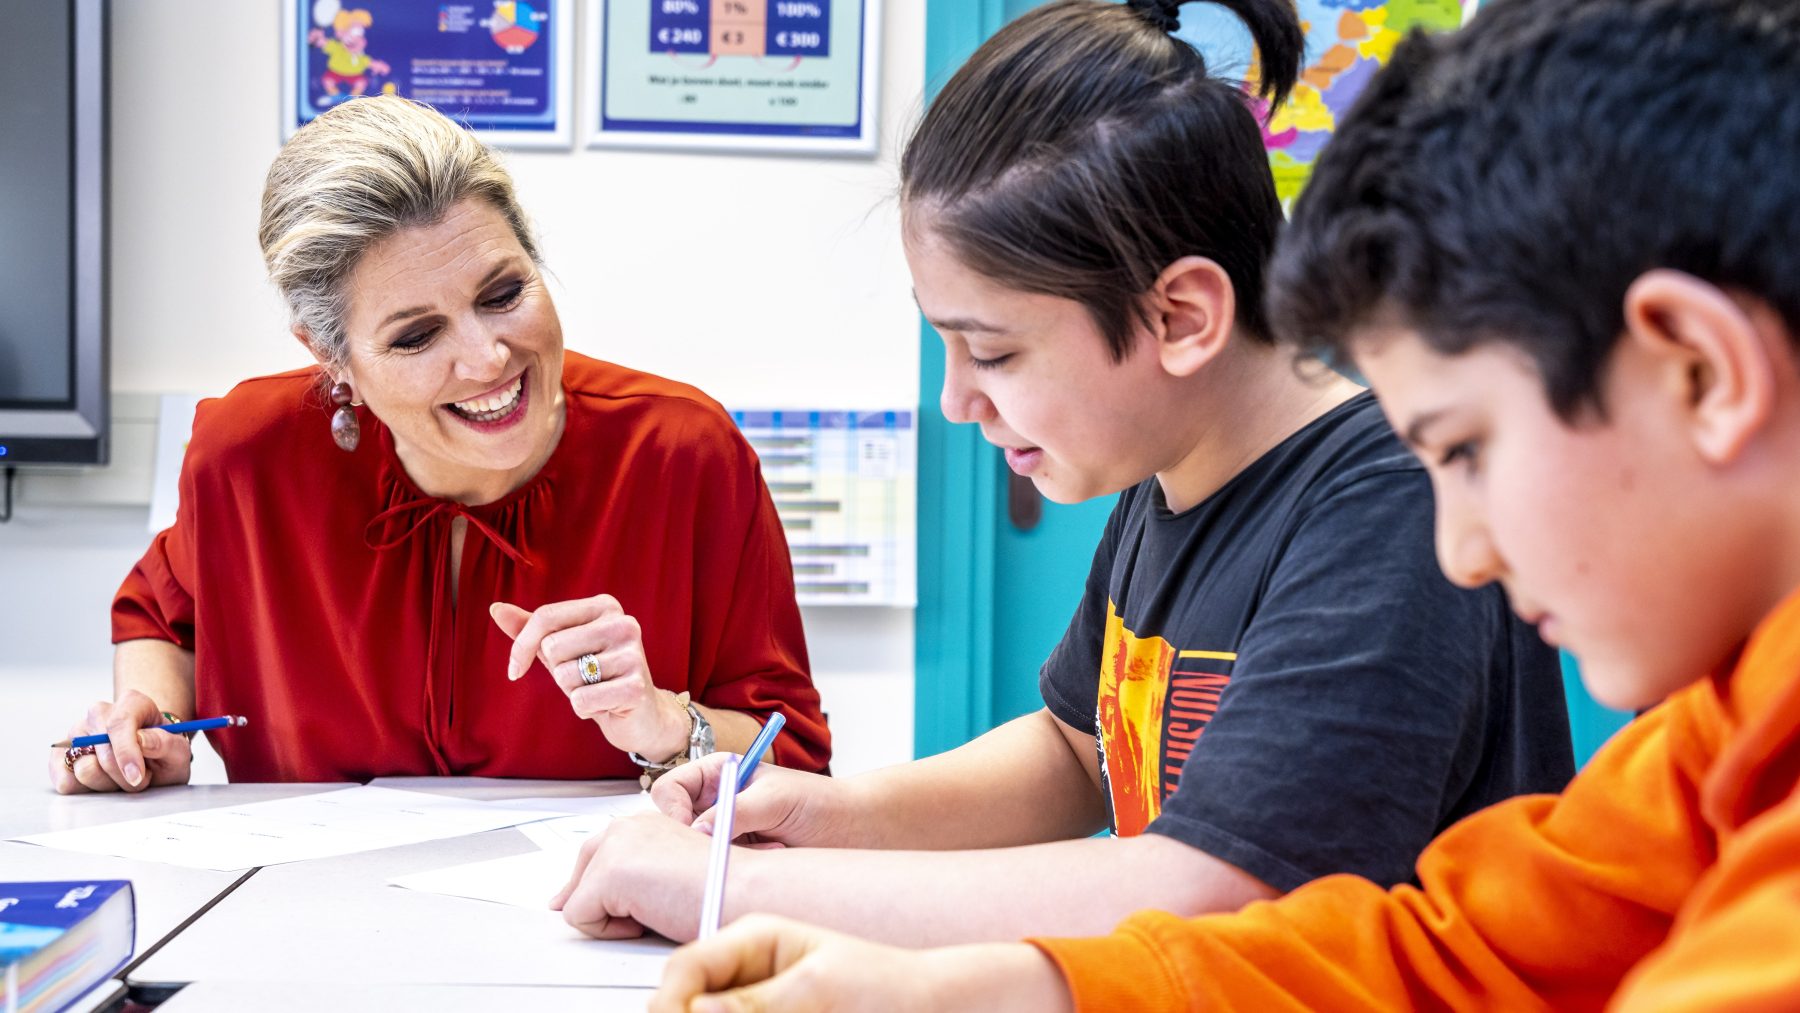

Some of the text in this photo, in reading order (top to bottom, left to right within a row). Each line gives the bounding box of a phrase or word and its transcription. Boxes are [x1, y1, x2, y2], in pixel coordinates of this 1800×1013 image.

[661, 0, 699, 14] 80%
[724, 2, 748, 15] 1%
[777, 2, 821, 18] 100%
[775, 32, 821, 48] € 300
